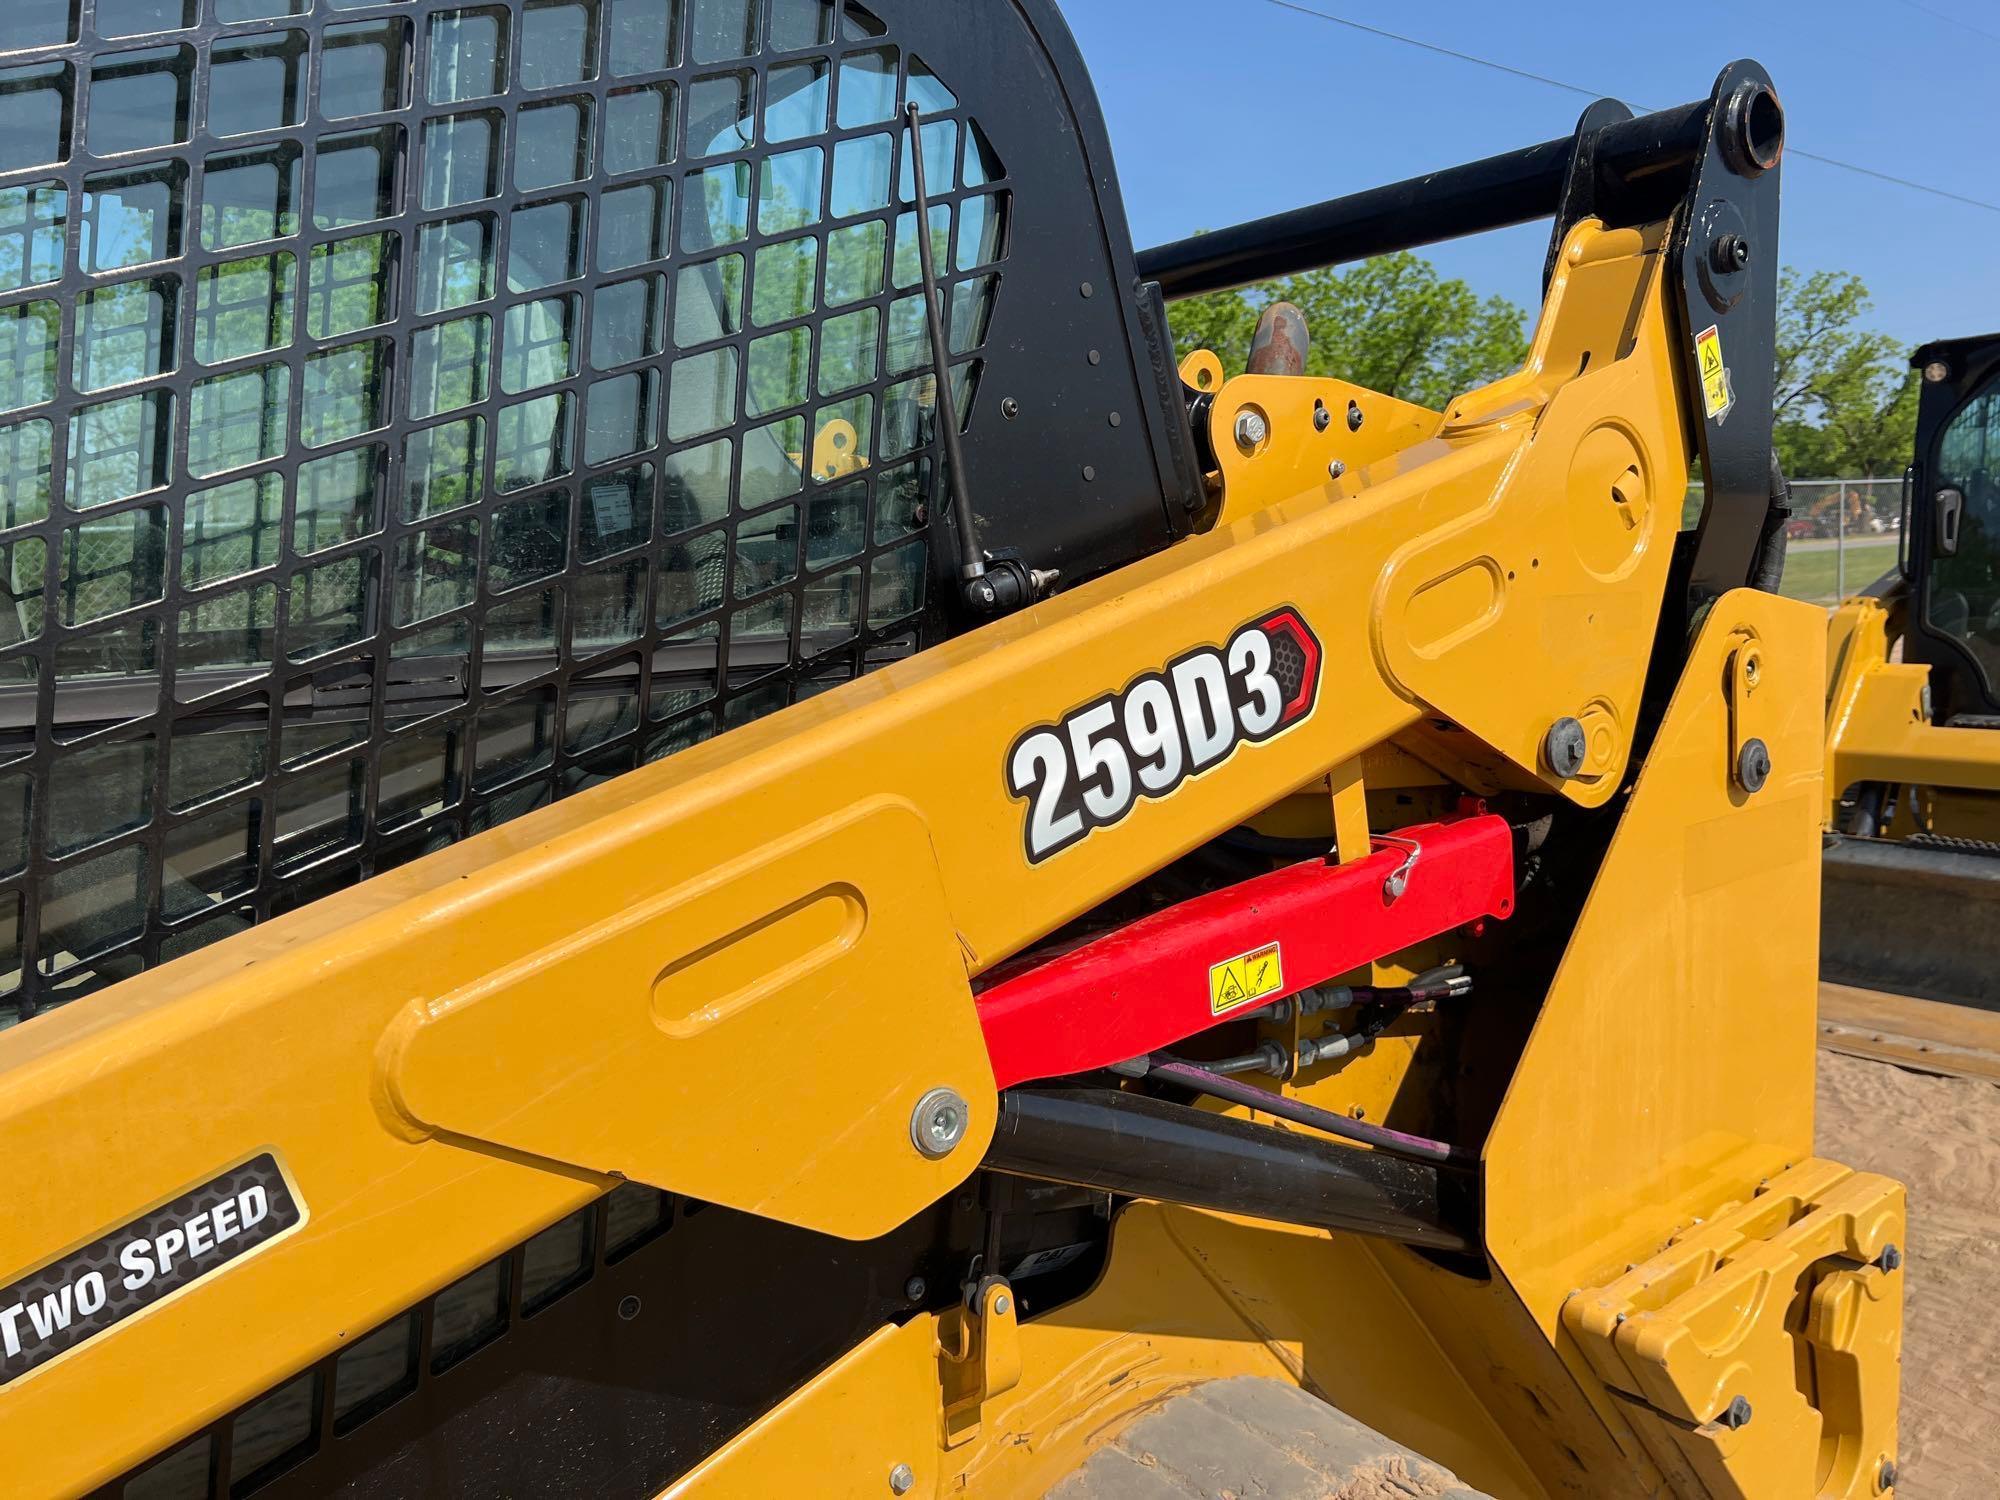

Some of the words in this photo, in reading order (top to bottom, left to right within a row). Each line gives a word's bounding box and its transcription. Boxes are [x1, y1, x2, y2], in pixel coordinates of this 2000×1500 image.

[1012, 629, 1282, 855] 259D3
[1252, 947, 1277, 960] WARNING
[0, 1271, 107, 1358] TWO
[119, 1185, 269, 1291] SPEED
[1034, 1247, 1071, 1264] CAT
